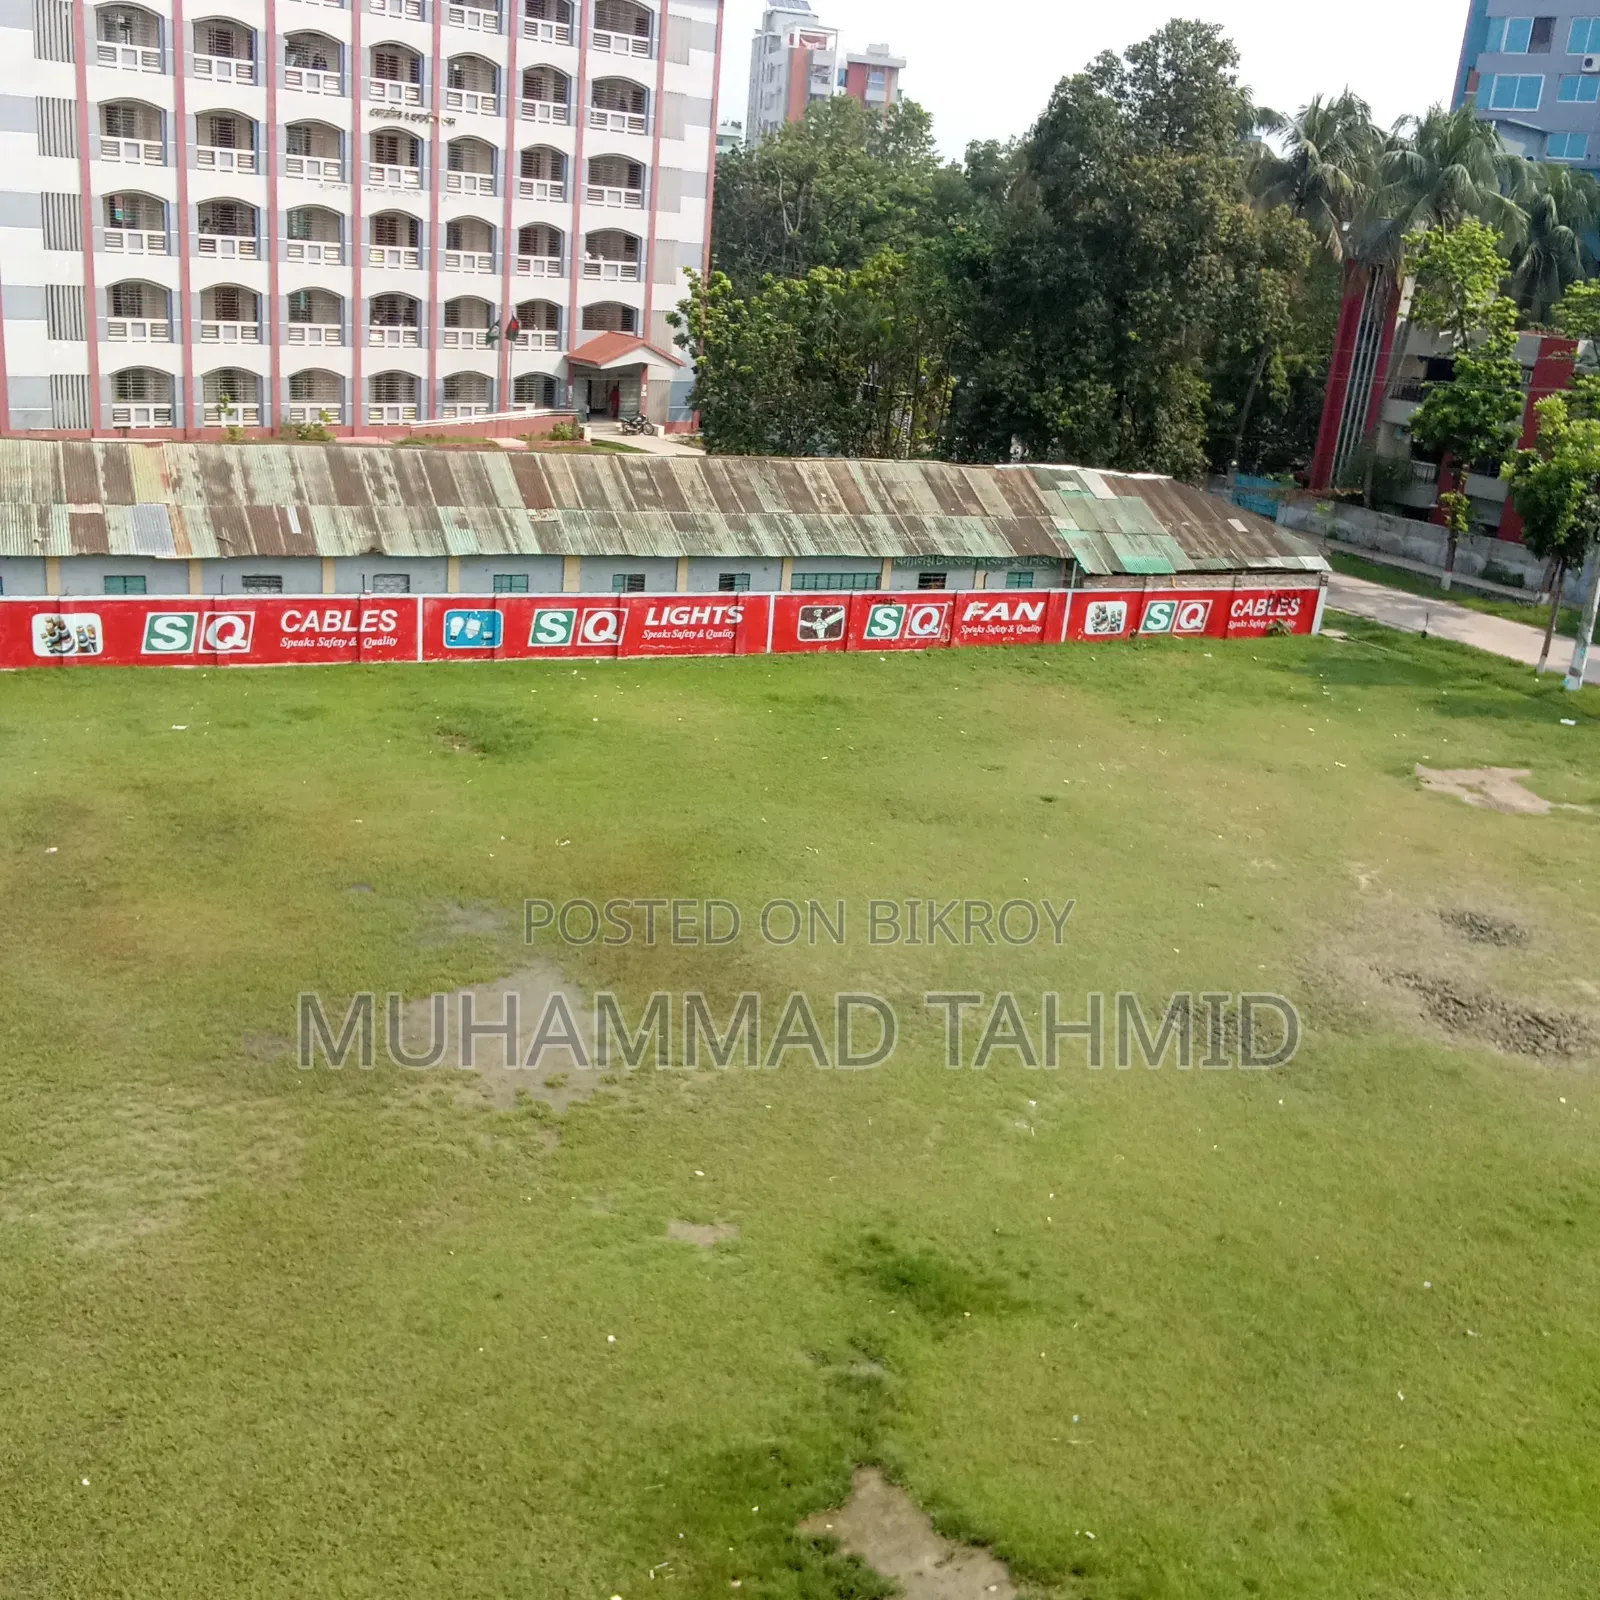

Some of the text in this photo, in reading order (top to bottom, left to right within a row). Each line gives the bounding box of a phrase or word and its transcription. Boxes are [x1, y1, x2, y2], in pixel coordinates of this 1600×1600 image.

[644, 606, 745, 626] LIGHTS
[962, 602, 1045, 621] FAN
[1230, 598, 1300, 617] CABLES
[280, 609, 398, 633] CABLES
[961, 625, 1041, 635] Speaks Safety & Quality
[280, 636, 398, 649] Speaks Safety & Quality
[642, 629, 735, 640] Speaks Safety & Quality
